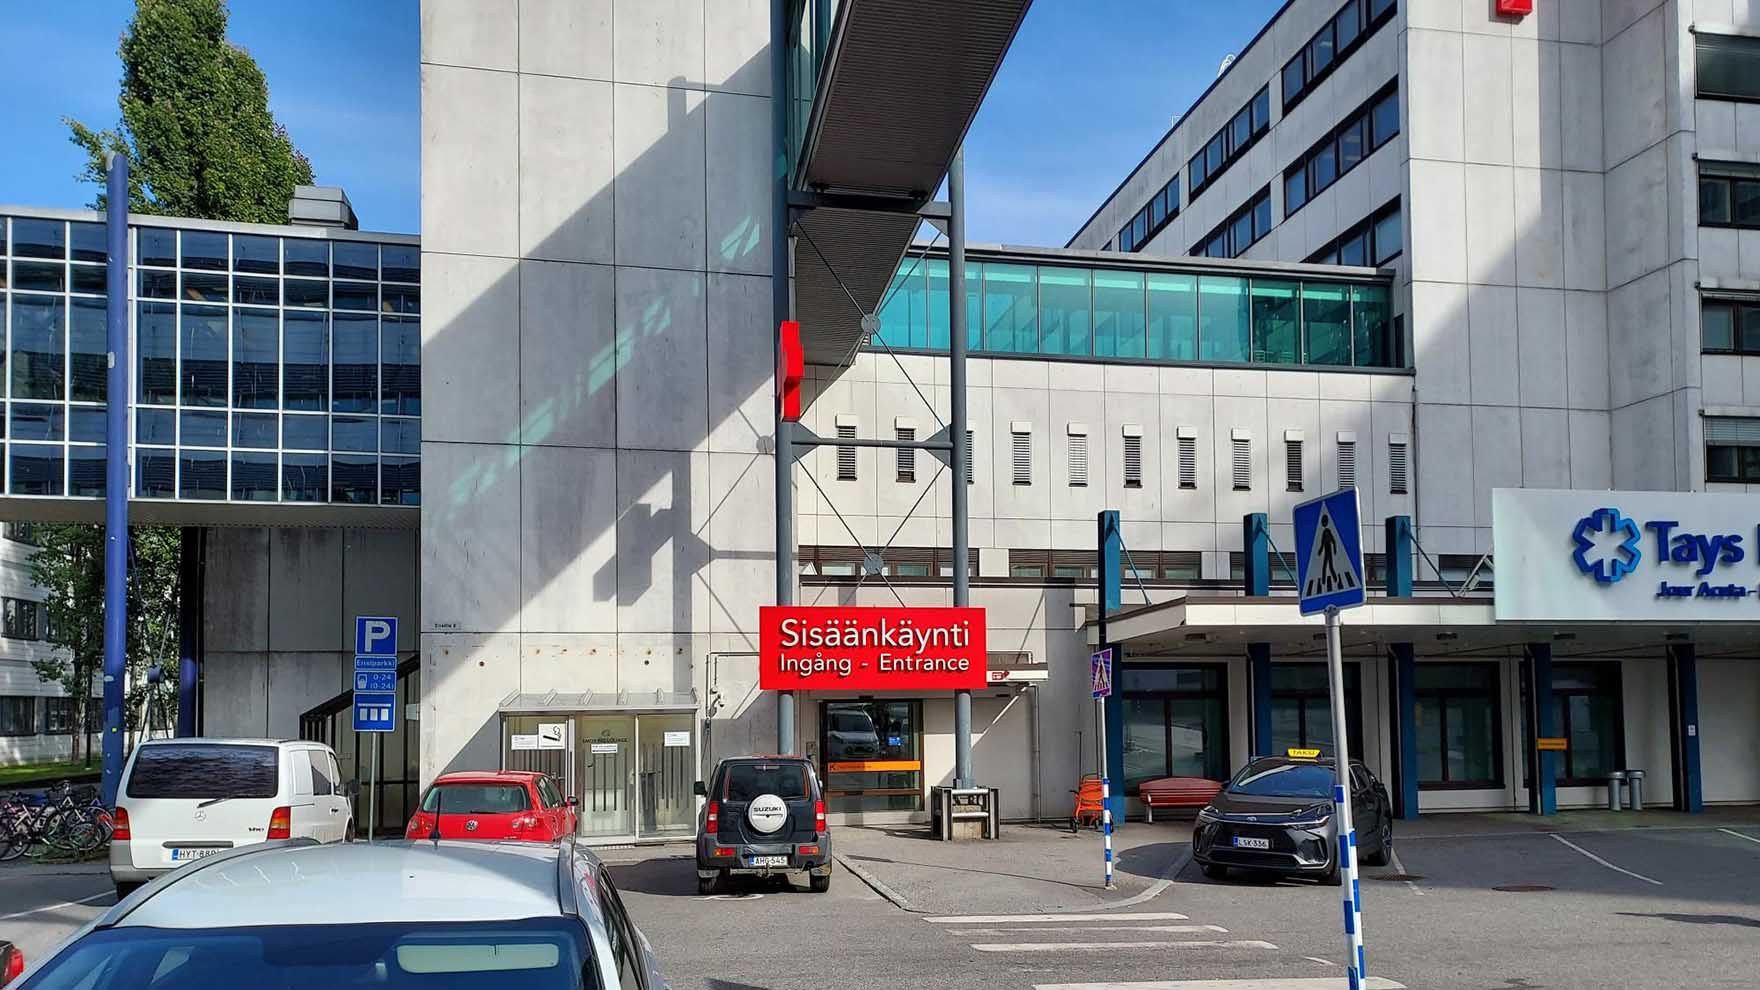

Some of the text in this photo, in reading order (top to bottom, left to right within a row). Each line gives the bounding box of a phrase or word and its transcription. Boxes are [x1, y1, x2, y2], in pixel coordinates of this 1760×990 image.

[1645, 521, 1745, 576] Tays
[365, 620, 391, 653] P
[780, 618, 970, 654] Sisäänkäynti
[780, 653, 852, 676] Ingång
[880, 654, 970, 672] Entrance
